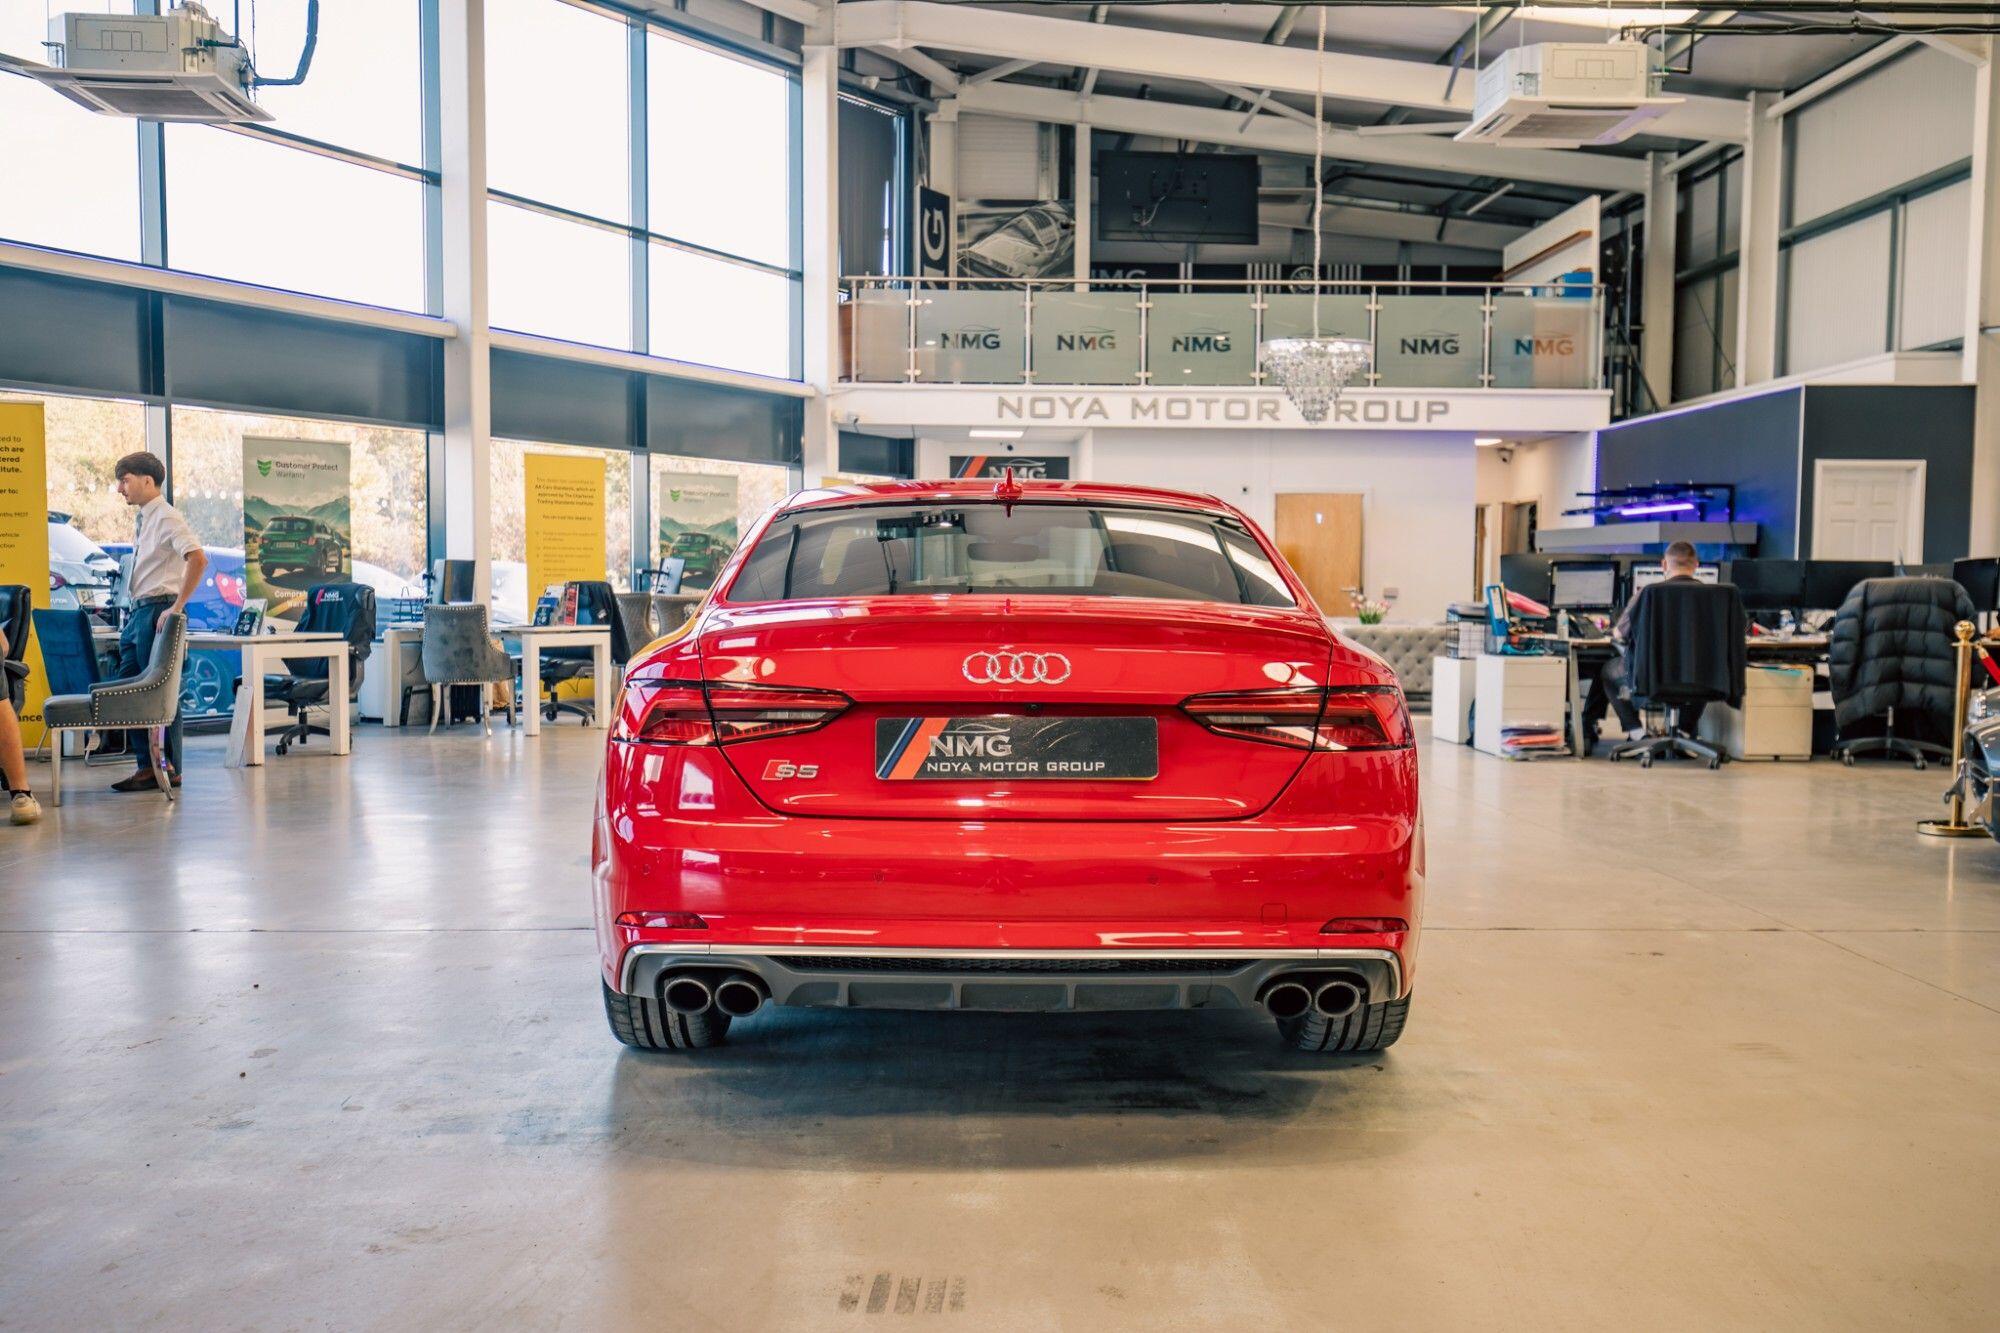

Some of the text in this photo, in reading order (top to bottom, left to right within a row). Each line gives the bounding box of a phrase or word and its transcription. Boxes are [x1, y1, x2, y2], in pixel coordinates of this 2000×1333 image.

[941, 333, 1000, 350] NMG
[1057, 335, 1116, 351] NMG
[1172, 336, 1231, 353] NMG
[1400, 338, 1460, 355] NMG
[1515, 338, 1574, 356] NMG
[998, 396, 1449, 422] NOYA MOTOR ROUP
[275, 461, 339, 471] Customer Protect
[989, 467, 1047, 478] NMG
[275, 471, 306, 480] Warranty
[928, 735, 1012, 757] NMG
[775, 764, 819, 779] S5
[927, 761, 1105, 772] NOYA MOTOR GROUP
